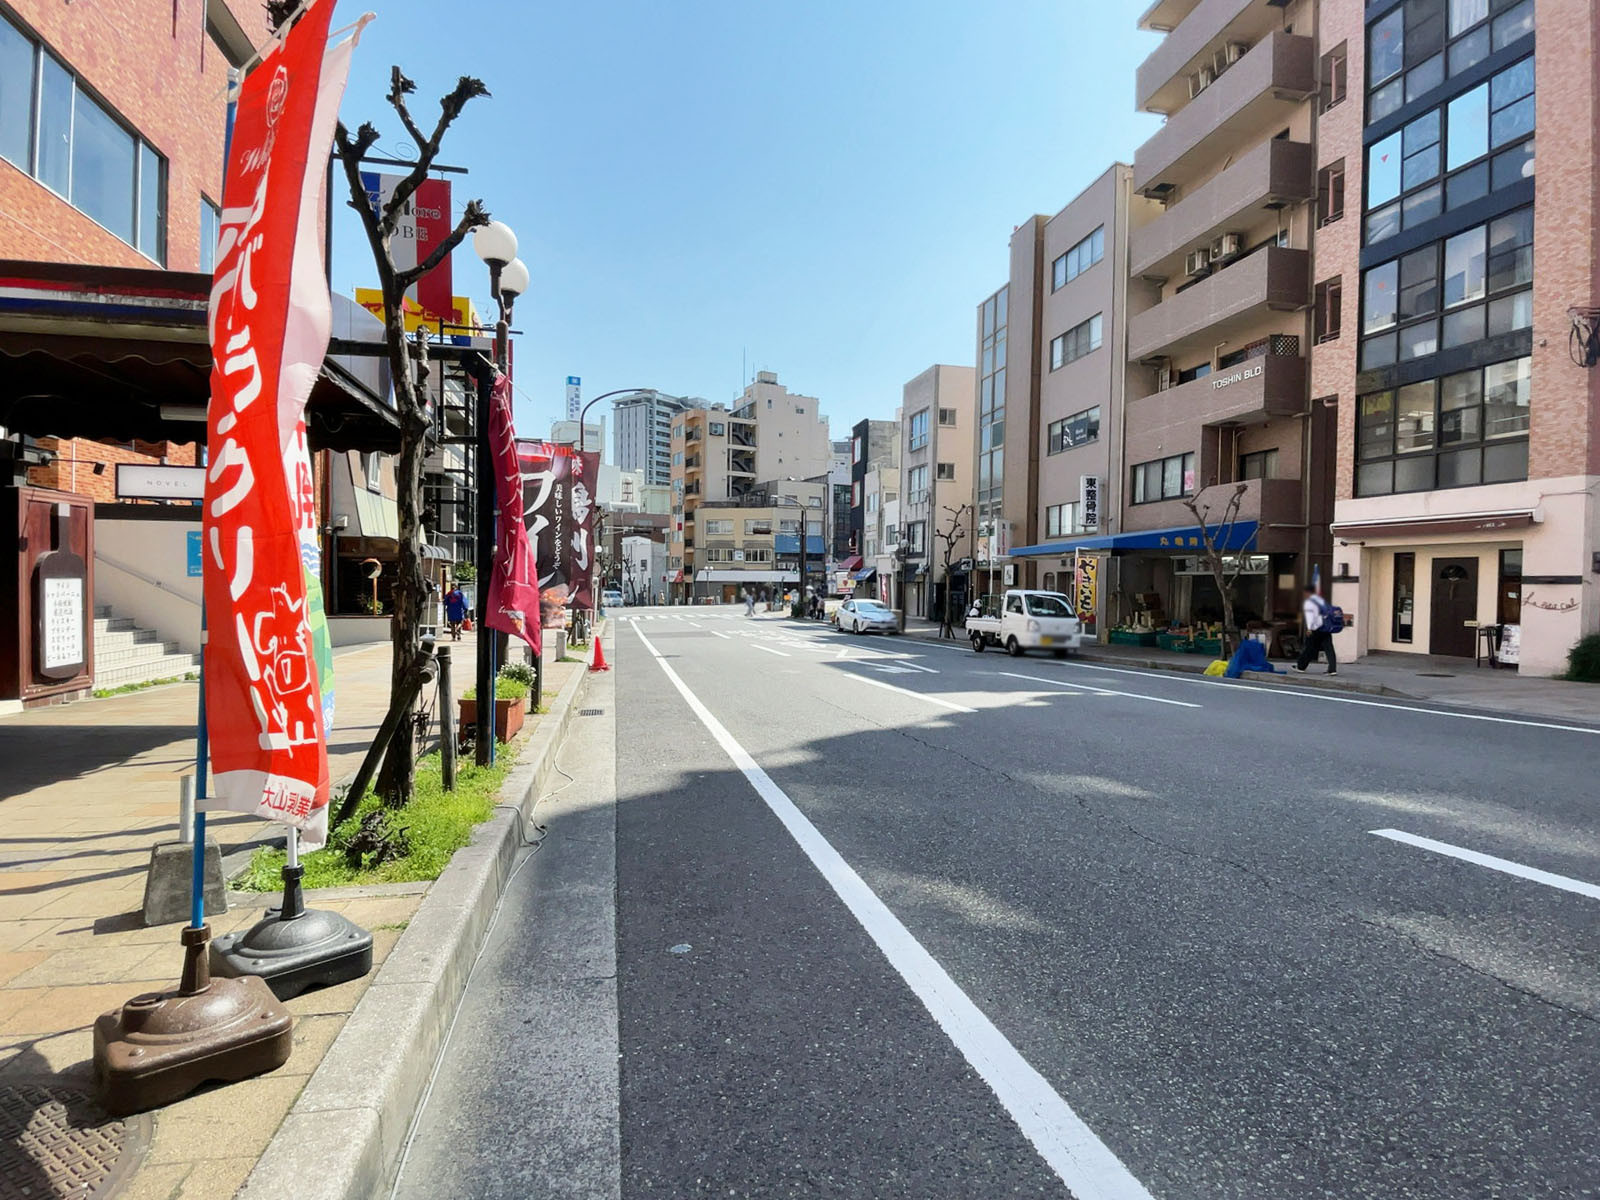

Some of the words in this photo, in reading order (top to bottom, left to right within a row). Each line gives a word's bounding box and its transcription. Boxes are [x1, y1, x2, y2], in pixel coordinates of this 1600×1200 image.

[1212, 373, 1242, 389] TOSHIN
[146, 480, 189, 488] NOVEL
[1085, 477, 1097, 525] 東整骨院
[554, 483, 564, 570] 美味しいワインをどうぞ
[260, 787, 312, 818] 大山乳業
